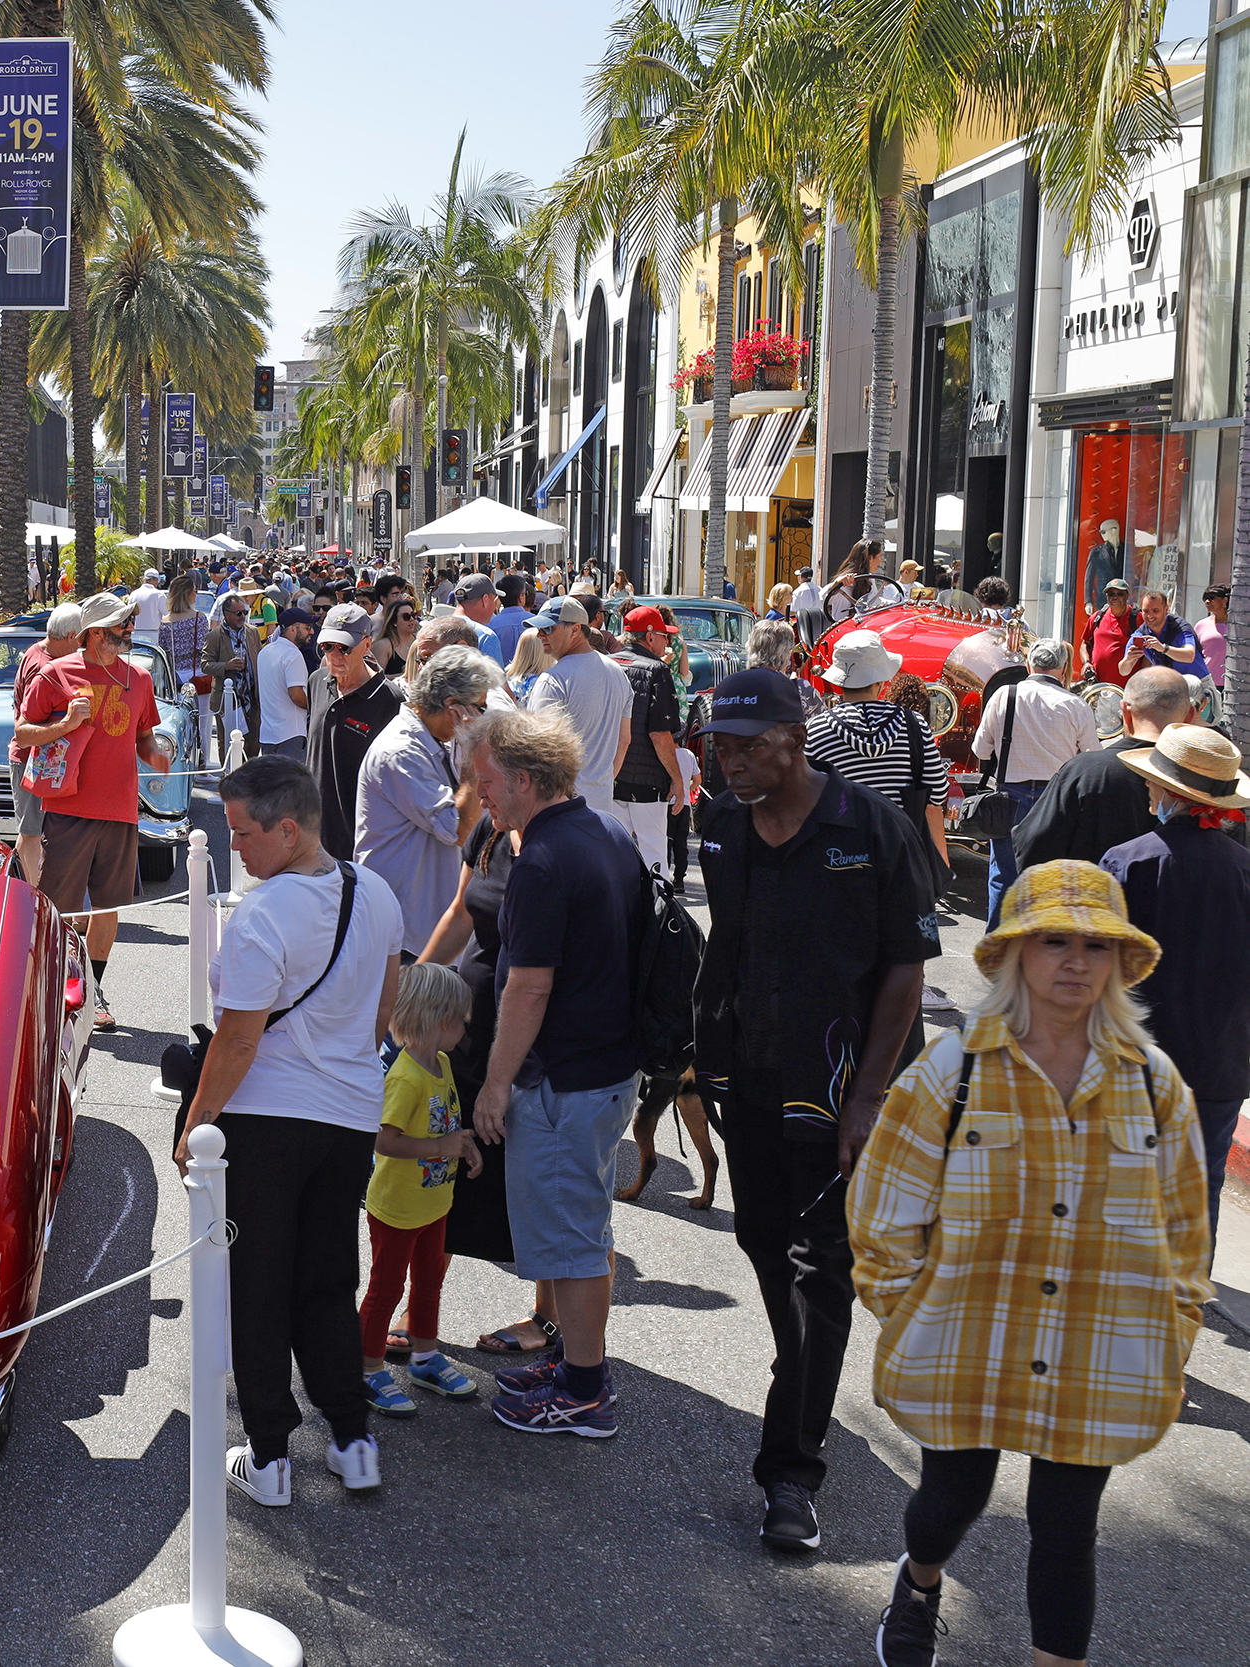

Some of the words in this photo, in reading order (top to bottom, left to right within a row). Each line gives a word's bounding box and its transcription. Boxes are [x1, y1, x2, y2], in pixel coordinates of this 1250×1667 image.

[0, 66, 26, 74] RODEO
[30, 66, 53, 74] DRIVE
[1062, 300, 1144, 339] PHILIPP
[170, 410, 190, 418] JUNE
[826, 847, 870, 866] Ramone
